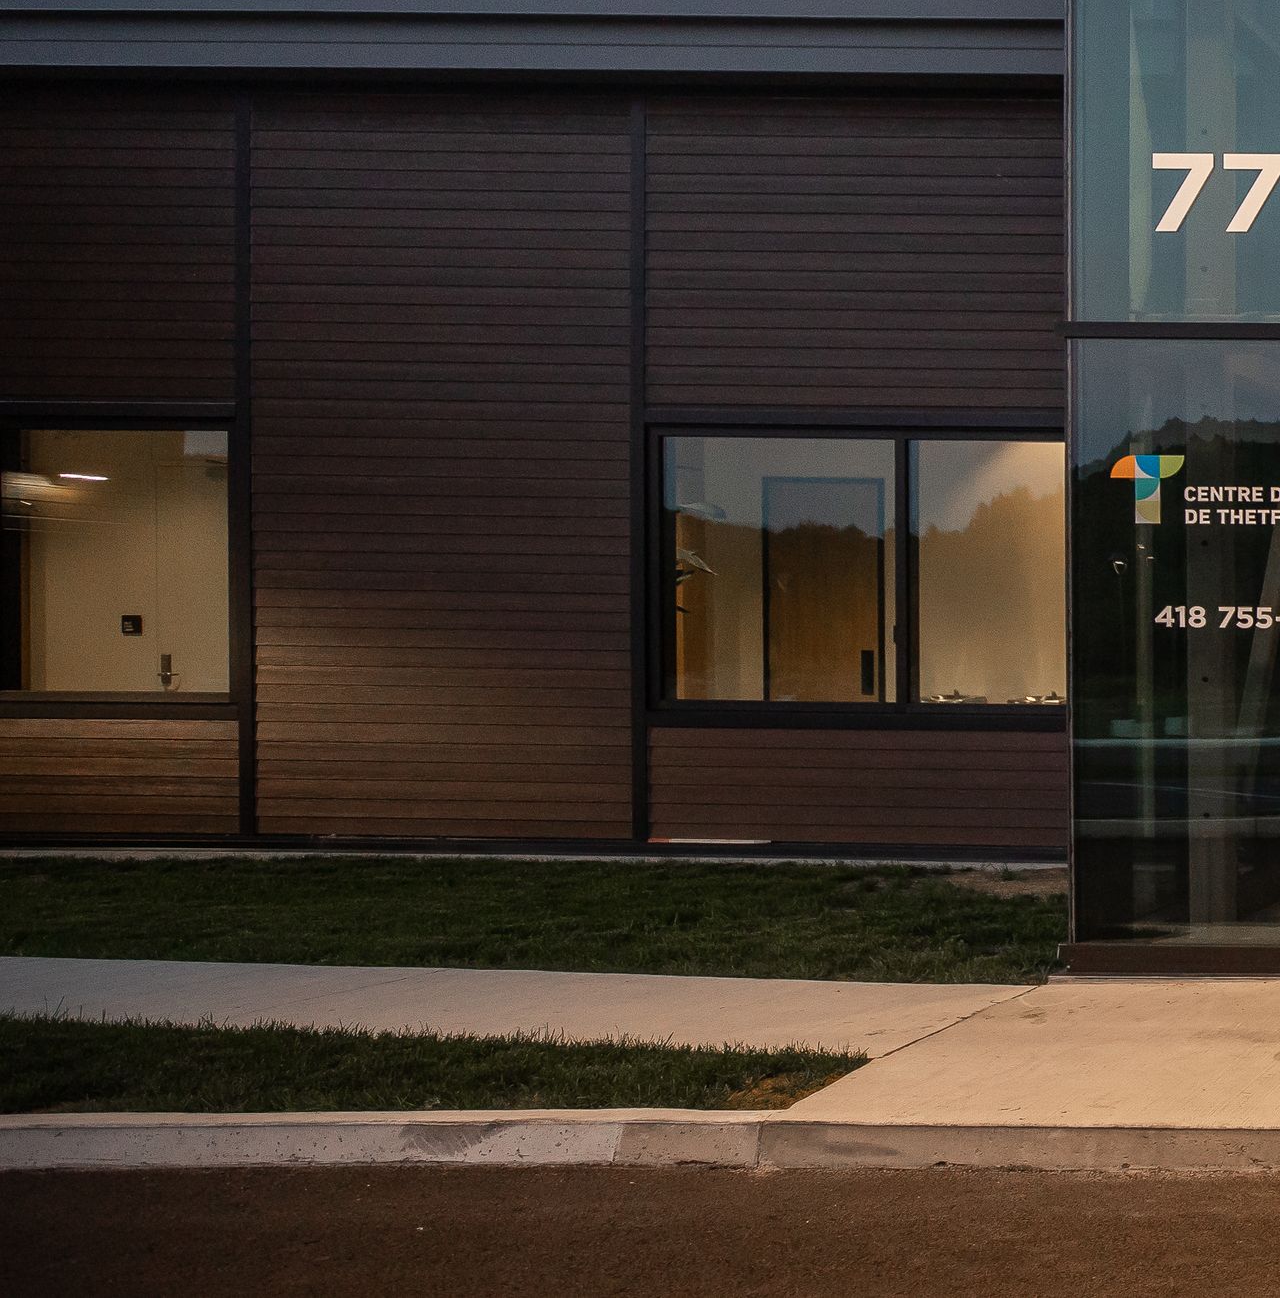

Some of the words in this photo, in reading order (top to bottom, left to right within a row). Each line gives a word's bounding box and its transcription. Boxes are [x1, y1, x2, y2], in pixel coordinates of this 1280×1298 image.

[1183, 485, 1264, 503] CENTRE
[1184, 508, 1211, 525] DE
[1154, 605, 1207, 629] 418
